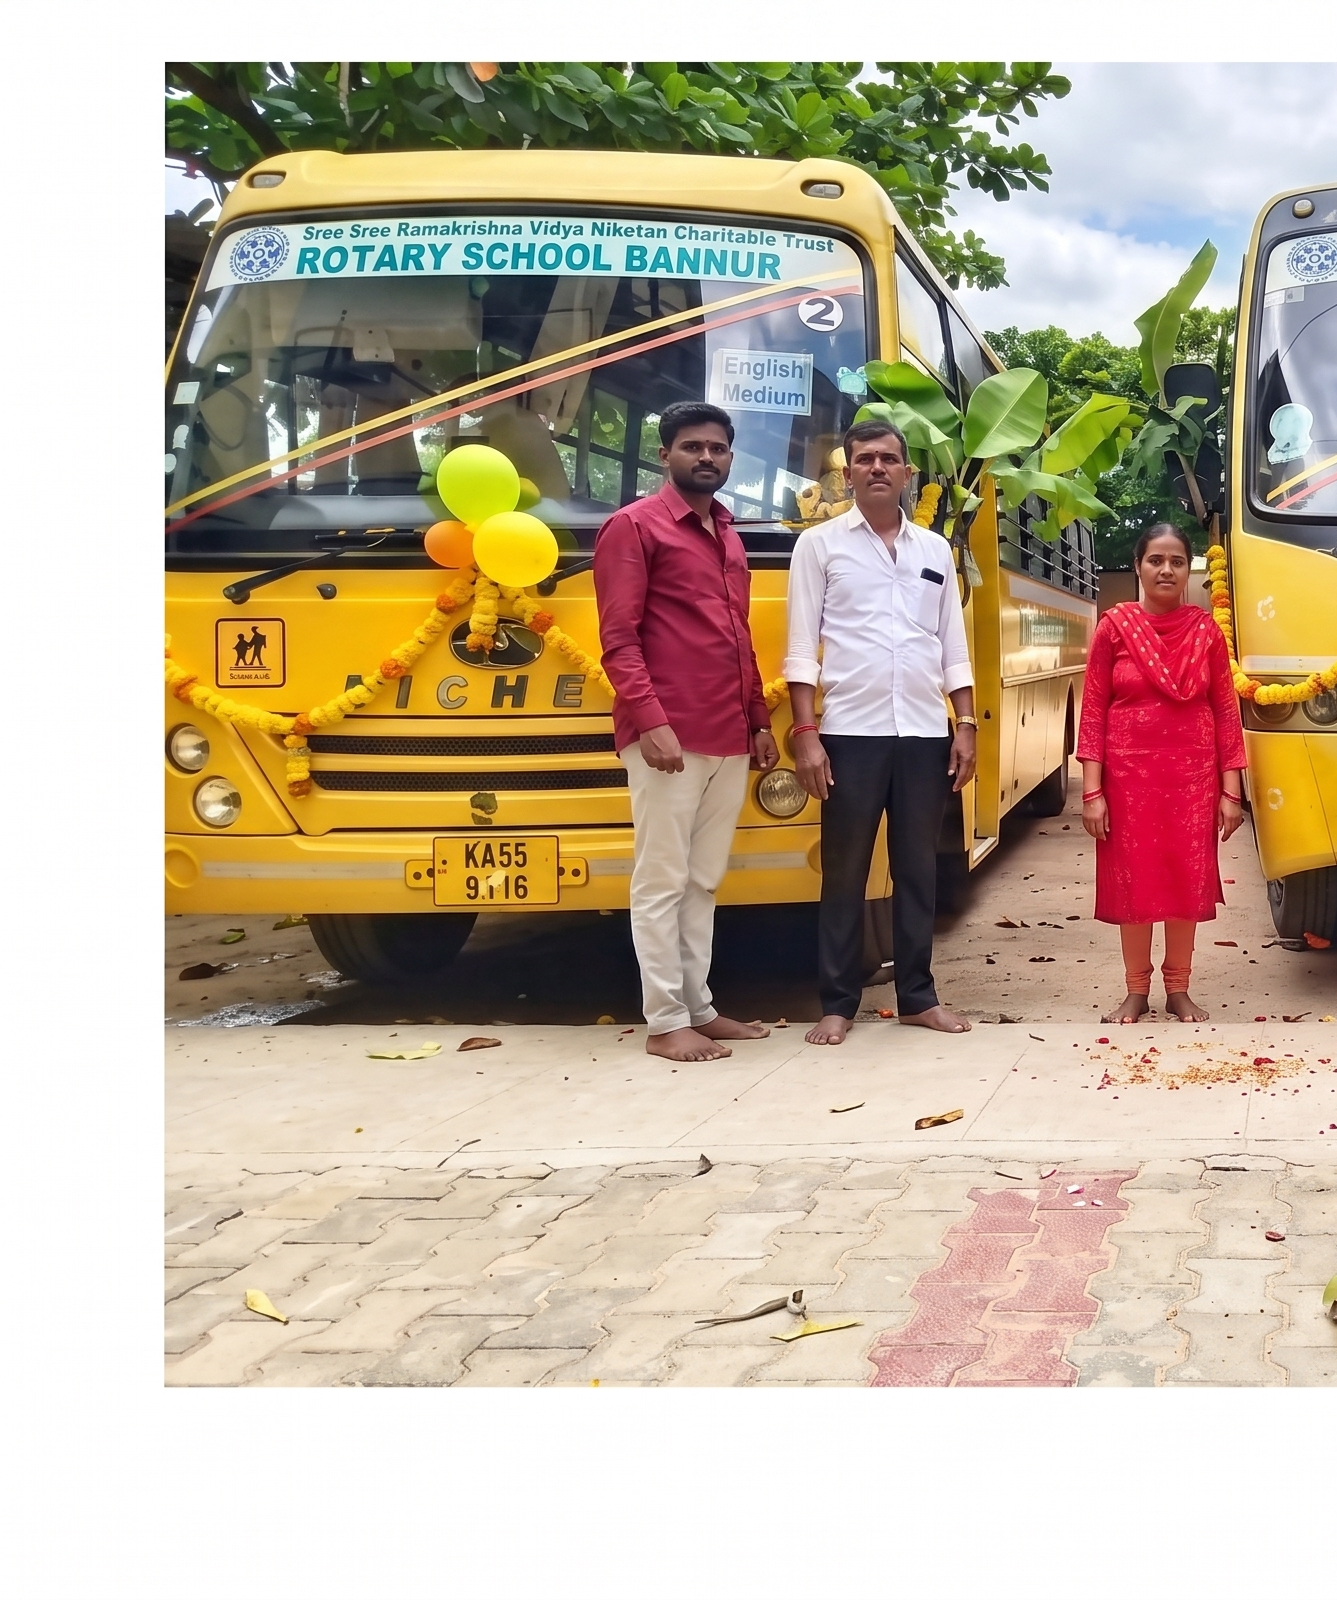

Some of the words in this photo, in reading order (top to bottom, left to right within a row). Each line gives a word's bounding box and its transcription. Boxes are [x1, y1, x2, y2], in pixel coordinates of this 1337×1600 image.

[302, 225, 344, 241] Sree
[349, 224, 391, 239] Sree
[397, 220, 523, 237] Ramakrishna
[529, 220, 584, 241] Vidya
[590, 222, 668, 239] Niketan
[674, 225, 777, 246] Charitable
[783, 233, 834, 253] Trust
[296, 243, 453, 275] ROTARY
[461, 242, 612, 271] SCHOOL
[624, 244, 782, 280] BANNUR
[805, 297, 835, 327] 2
[724, 356, 803, 380] English
[722, 383, 806, 407] Medium
[464, 840, 528, 869] KA55
